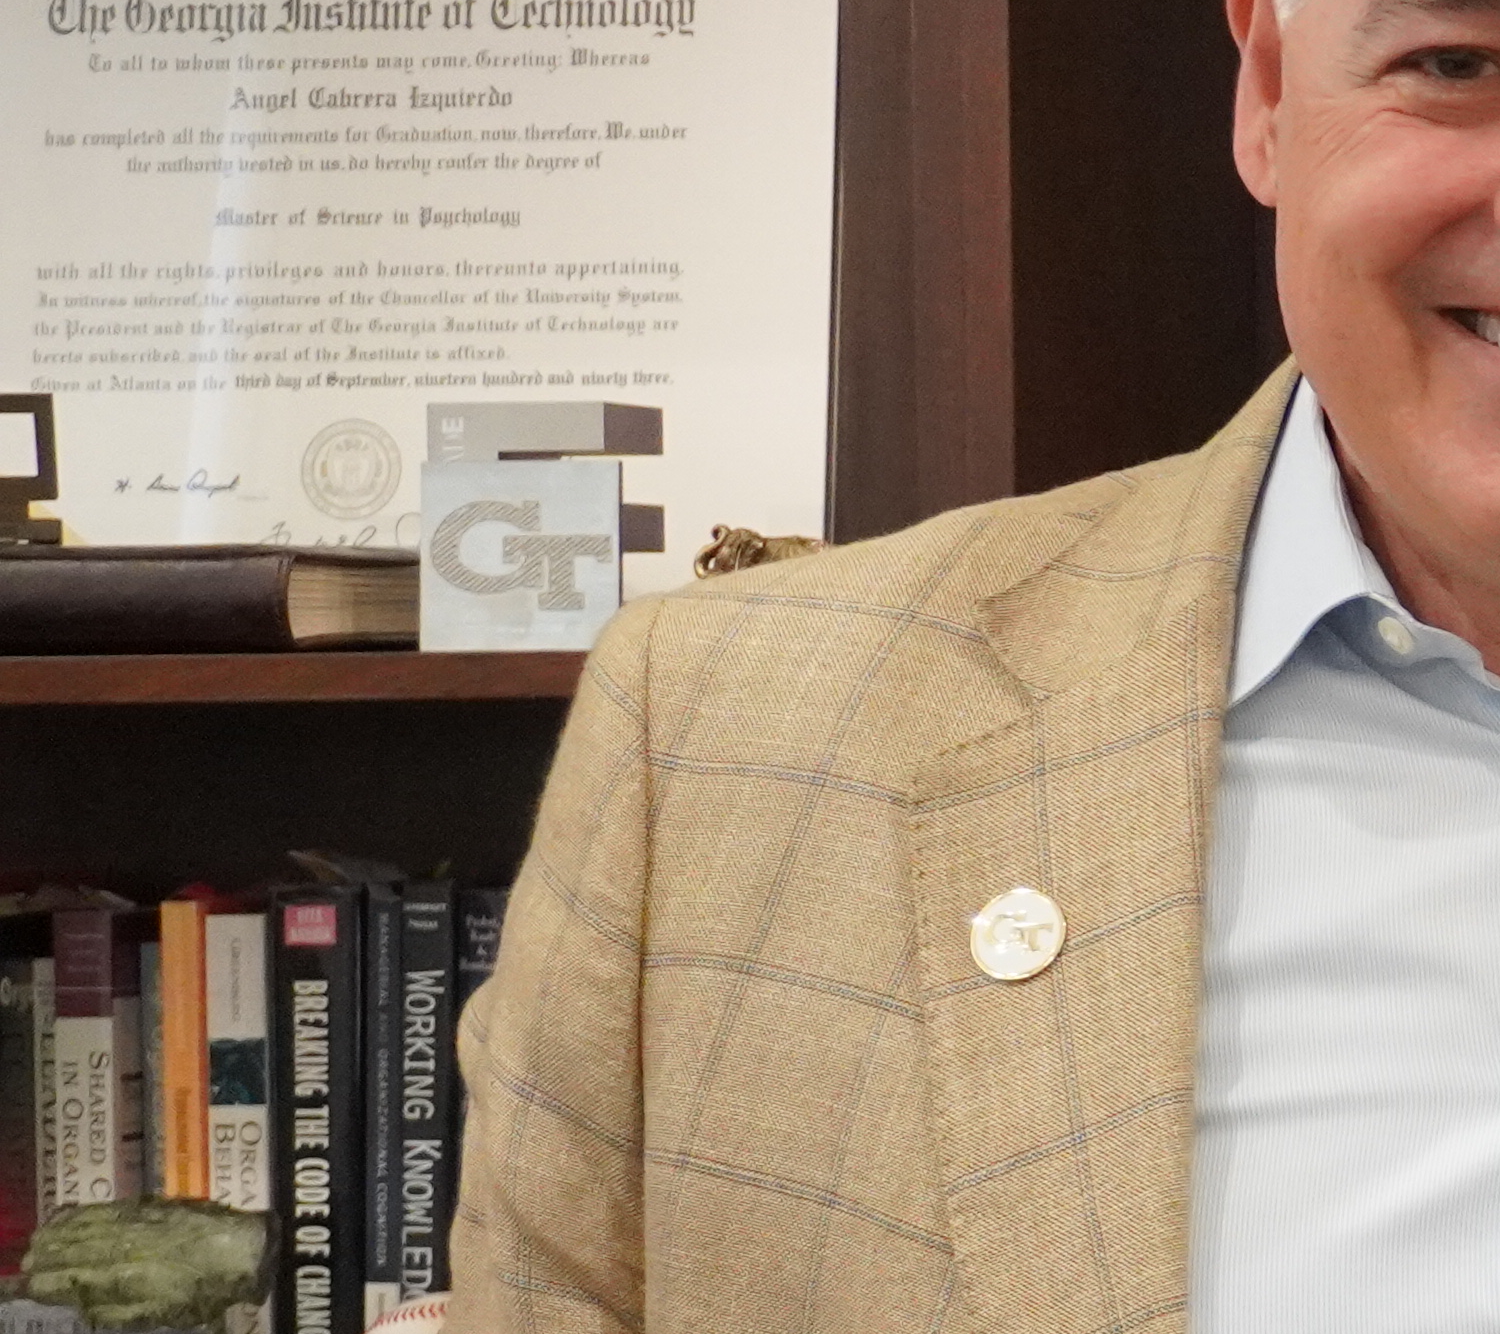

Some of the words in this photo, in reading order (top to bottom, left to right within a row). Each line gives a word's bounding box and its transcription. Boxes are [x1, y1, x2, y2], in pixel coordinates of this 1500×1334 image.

[88, 52, 113, 73] To
[120, 51, 144, 72] all
[150, 53, 169, 72] to
[175, 53, 231, 72] whom
[237, 52, 286, 72] these
[291, 54, 369, 75] presents
[376, 55, 415, 76] may
[421, 55, 471, 71] come,
[569, 47, 651, 68] Whereas
[229, 86, 298, 114] Angel
[307, 85, 398, 110] Cabrera
[409, 84, 514, 113] Izquierdo
[44, 129, 76, 149] has
[81, 127, 166, 151] completed
[172, 126, 195, 147] all
[200, 126, 226, 146] the
[230, 126, 340, 151] requirements
[345, 124, 371, 145] for
[639, 124, 688, 141] under
[125, 155, 152, 174] the
[155, 155, 234, 178] authority
[238, 156, 294, 174] vested
[298, 156, 315, 173] in
[348, 155, 369, 173] do
[374, 153, 432, 176] hereby
[436, 153, 490, 170] confer
[494, 152, 520, 170] the
[523, 152, 580, 174] degree
[584, 151, 602, 169] of
[214, 207, 279, 227] Master
[287, 207, 306, 226] of
[316, 205, 384, 226] Science
[392, 208, 410, 226] in
[417, 204, 522, 229] Psychology
[430, 499, 614, 611] GT
[982, 910, 1055, 954] GT
[294, 979, 328, 1096] BREAKING
[402, 969, 446, 1121] WORKING
[62, 1061, 80, 1086] IN
[88, 1050, 111, 1167] SHARED
[295, 1104, 329, 1150] THE
[295, 1157, 330, 1217] CODE
[296, 1225, 330, 1258] OF
